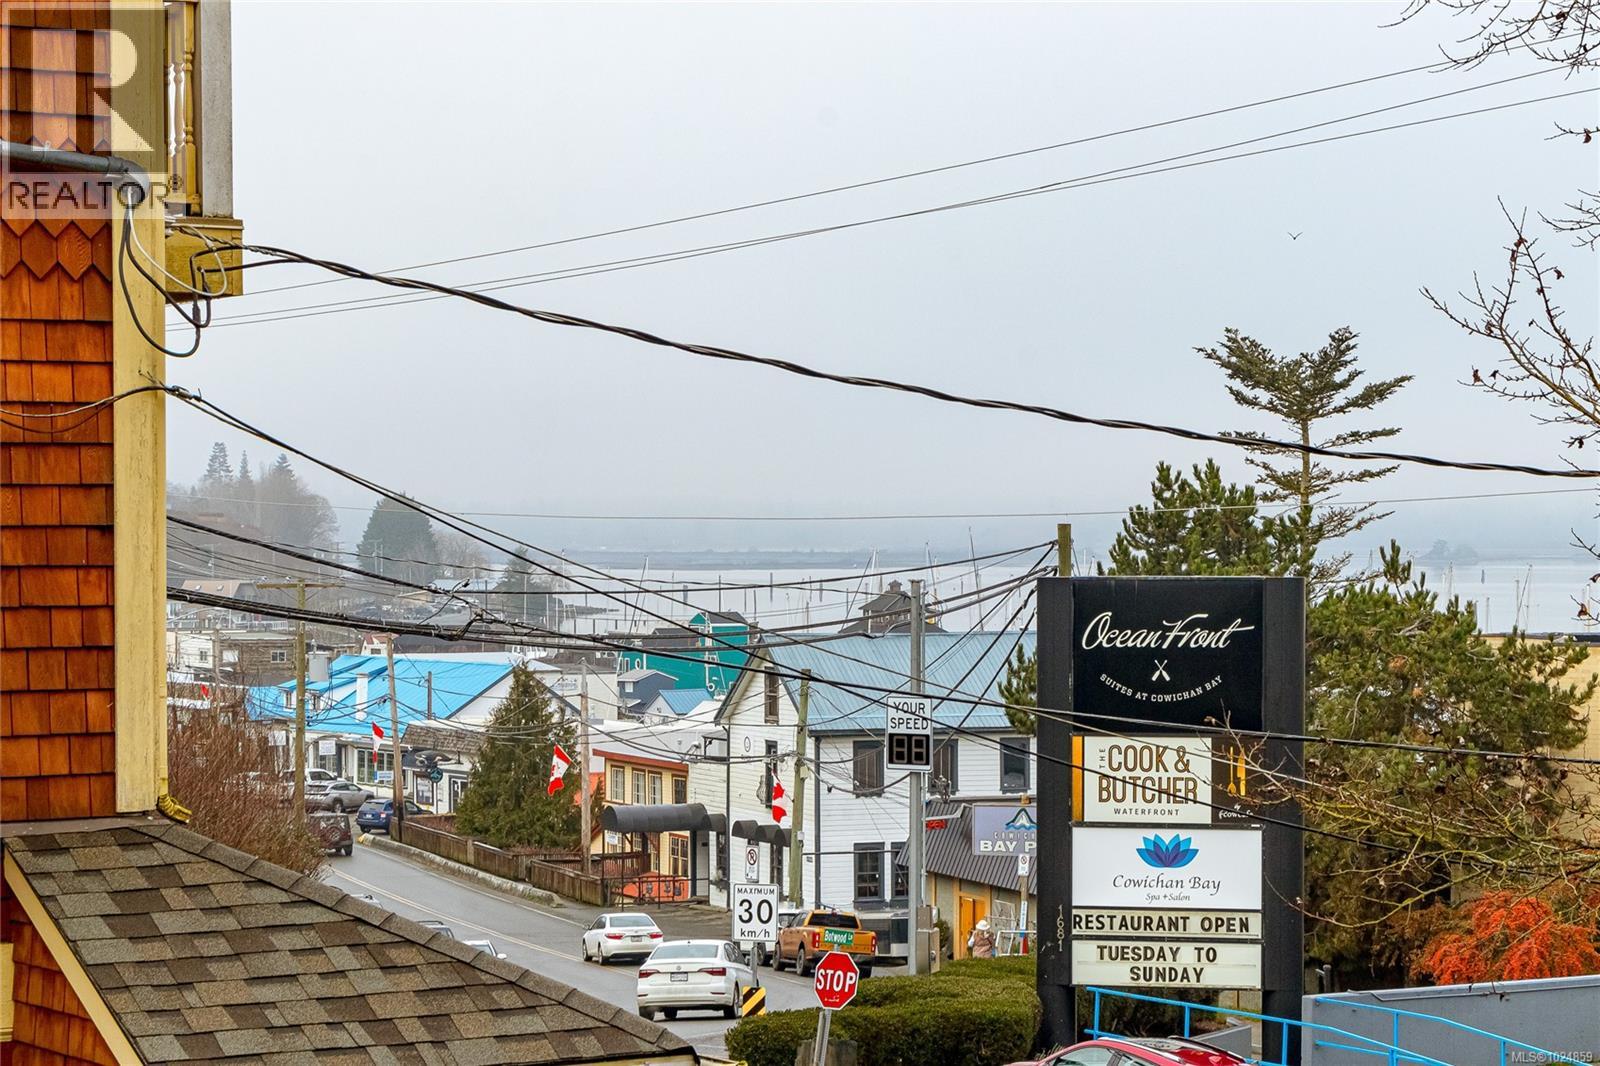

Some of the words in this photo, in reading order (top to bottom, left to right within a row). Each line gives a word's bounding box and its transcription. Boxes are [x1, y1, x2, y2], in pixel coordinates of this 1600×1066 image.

[1100, 673, 1133, 697] SUITES
[1135, 691, 1149, 701] AT
[1151, 687, 1203, 703] COWICHAN
[1206, 675, 1223, 691] BAY
[893, 702, 925, 714] YOUR
[890, 717, 929, 730] SPEED
[1108, 744, 1169, 773] COOK
[1174, 745, 1190, 773] &
[1098, 775, 1198, 804] BUTCHER
[1114, 808, 1180, 816] WATERFRONT
[980, 840, 1018, 852] BAY
[737, 887, 775, 896] MAXIMUM
[1112, 873, 1184, 889] Cowichan
[1188, 876, 1221, 896] Bay
[1145, 893, 1160, 904] Spa
[738, 899, 773, 924] 30
[1073, 914, 1190, 932] RESTAURANT
[1200, 917, 1249, 933] OPEN
[740, 928, 770, 938] km/h
[1097, 945, 1181, 962] TUESDAY
[1194, 947, 1217, 962] TO
[816, 969, 856, 993] STOP
[1130, 966, 1204, 983] SUNDAY
